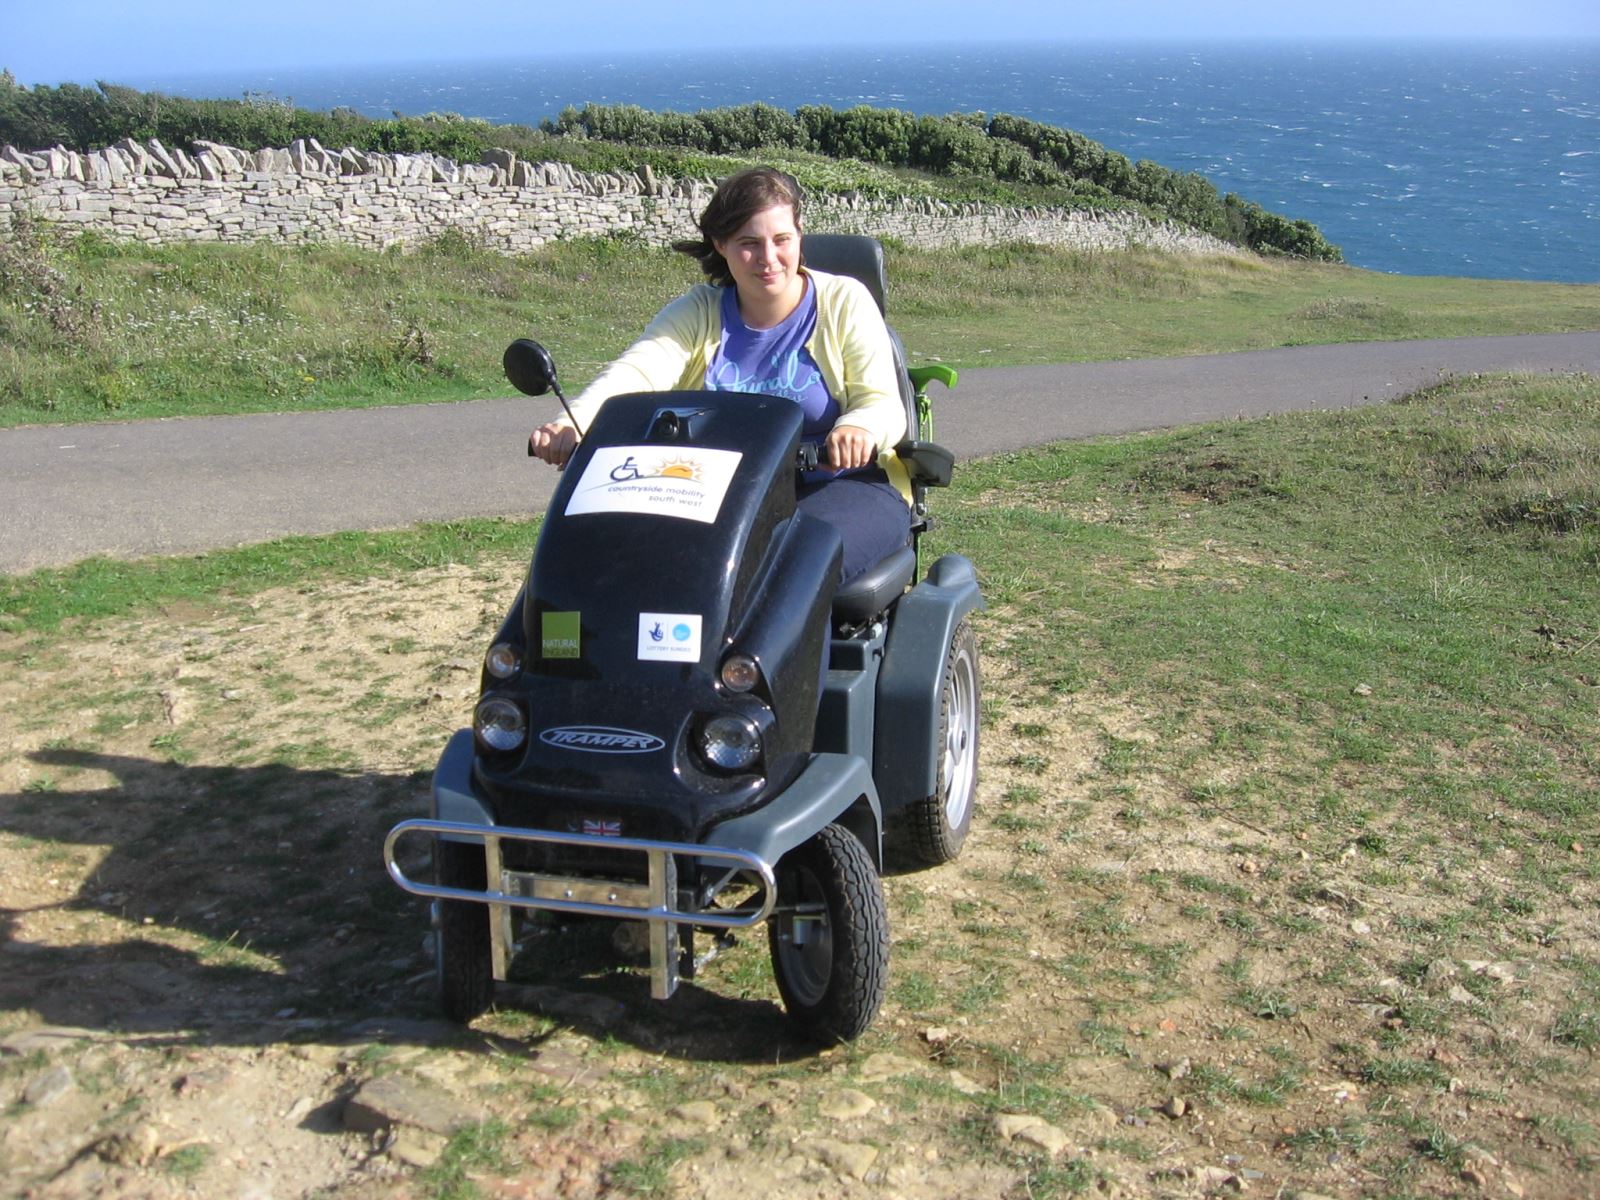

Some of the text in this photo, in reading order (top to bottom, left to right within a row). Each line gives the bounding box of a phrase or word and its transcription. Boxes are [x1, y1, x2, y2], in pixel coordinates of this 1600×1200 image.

[608, 485, 705, 499] countryside mobility
[649, 495, 702, 507] south west
[543, 639, 577, 649] NATURAL
[552, 730, 654, 748] TRAMPER
